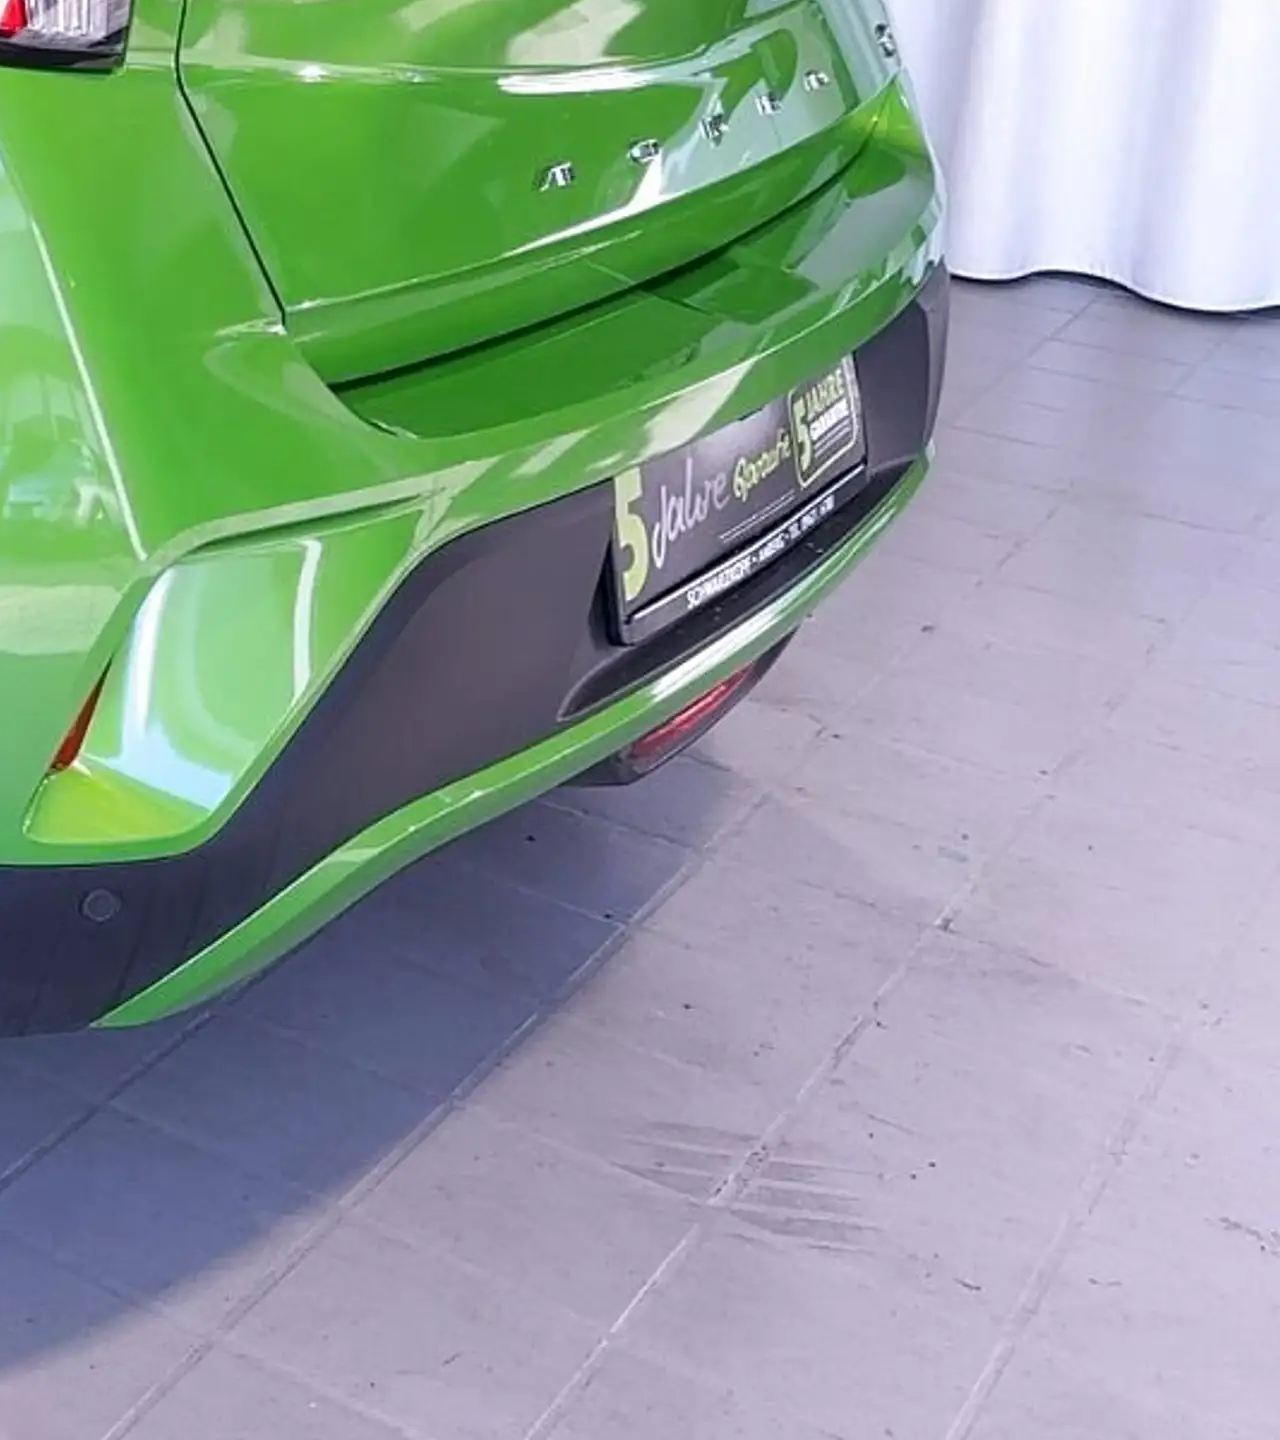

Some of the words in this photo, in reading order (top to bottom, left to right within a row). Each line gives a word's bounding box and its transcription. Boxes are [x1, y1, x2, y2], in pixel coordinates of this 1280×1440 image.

[793, 396, 811, 471] 5
[614, 465, 649, 602] 5
[652, 458, 729, 569] Jahre
